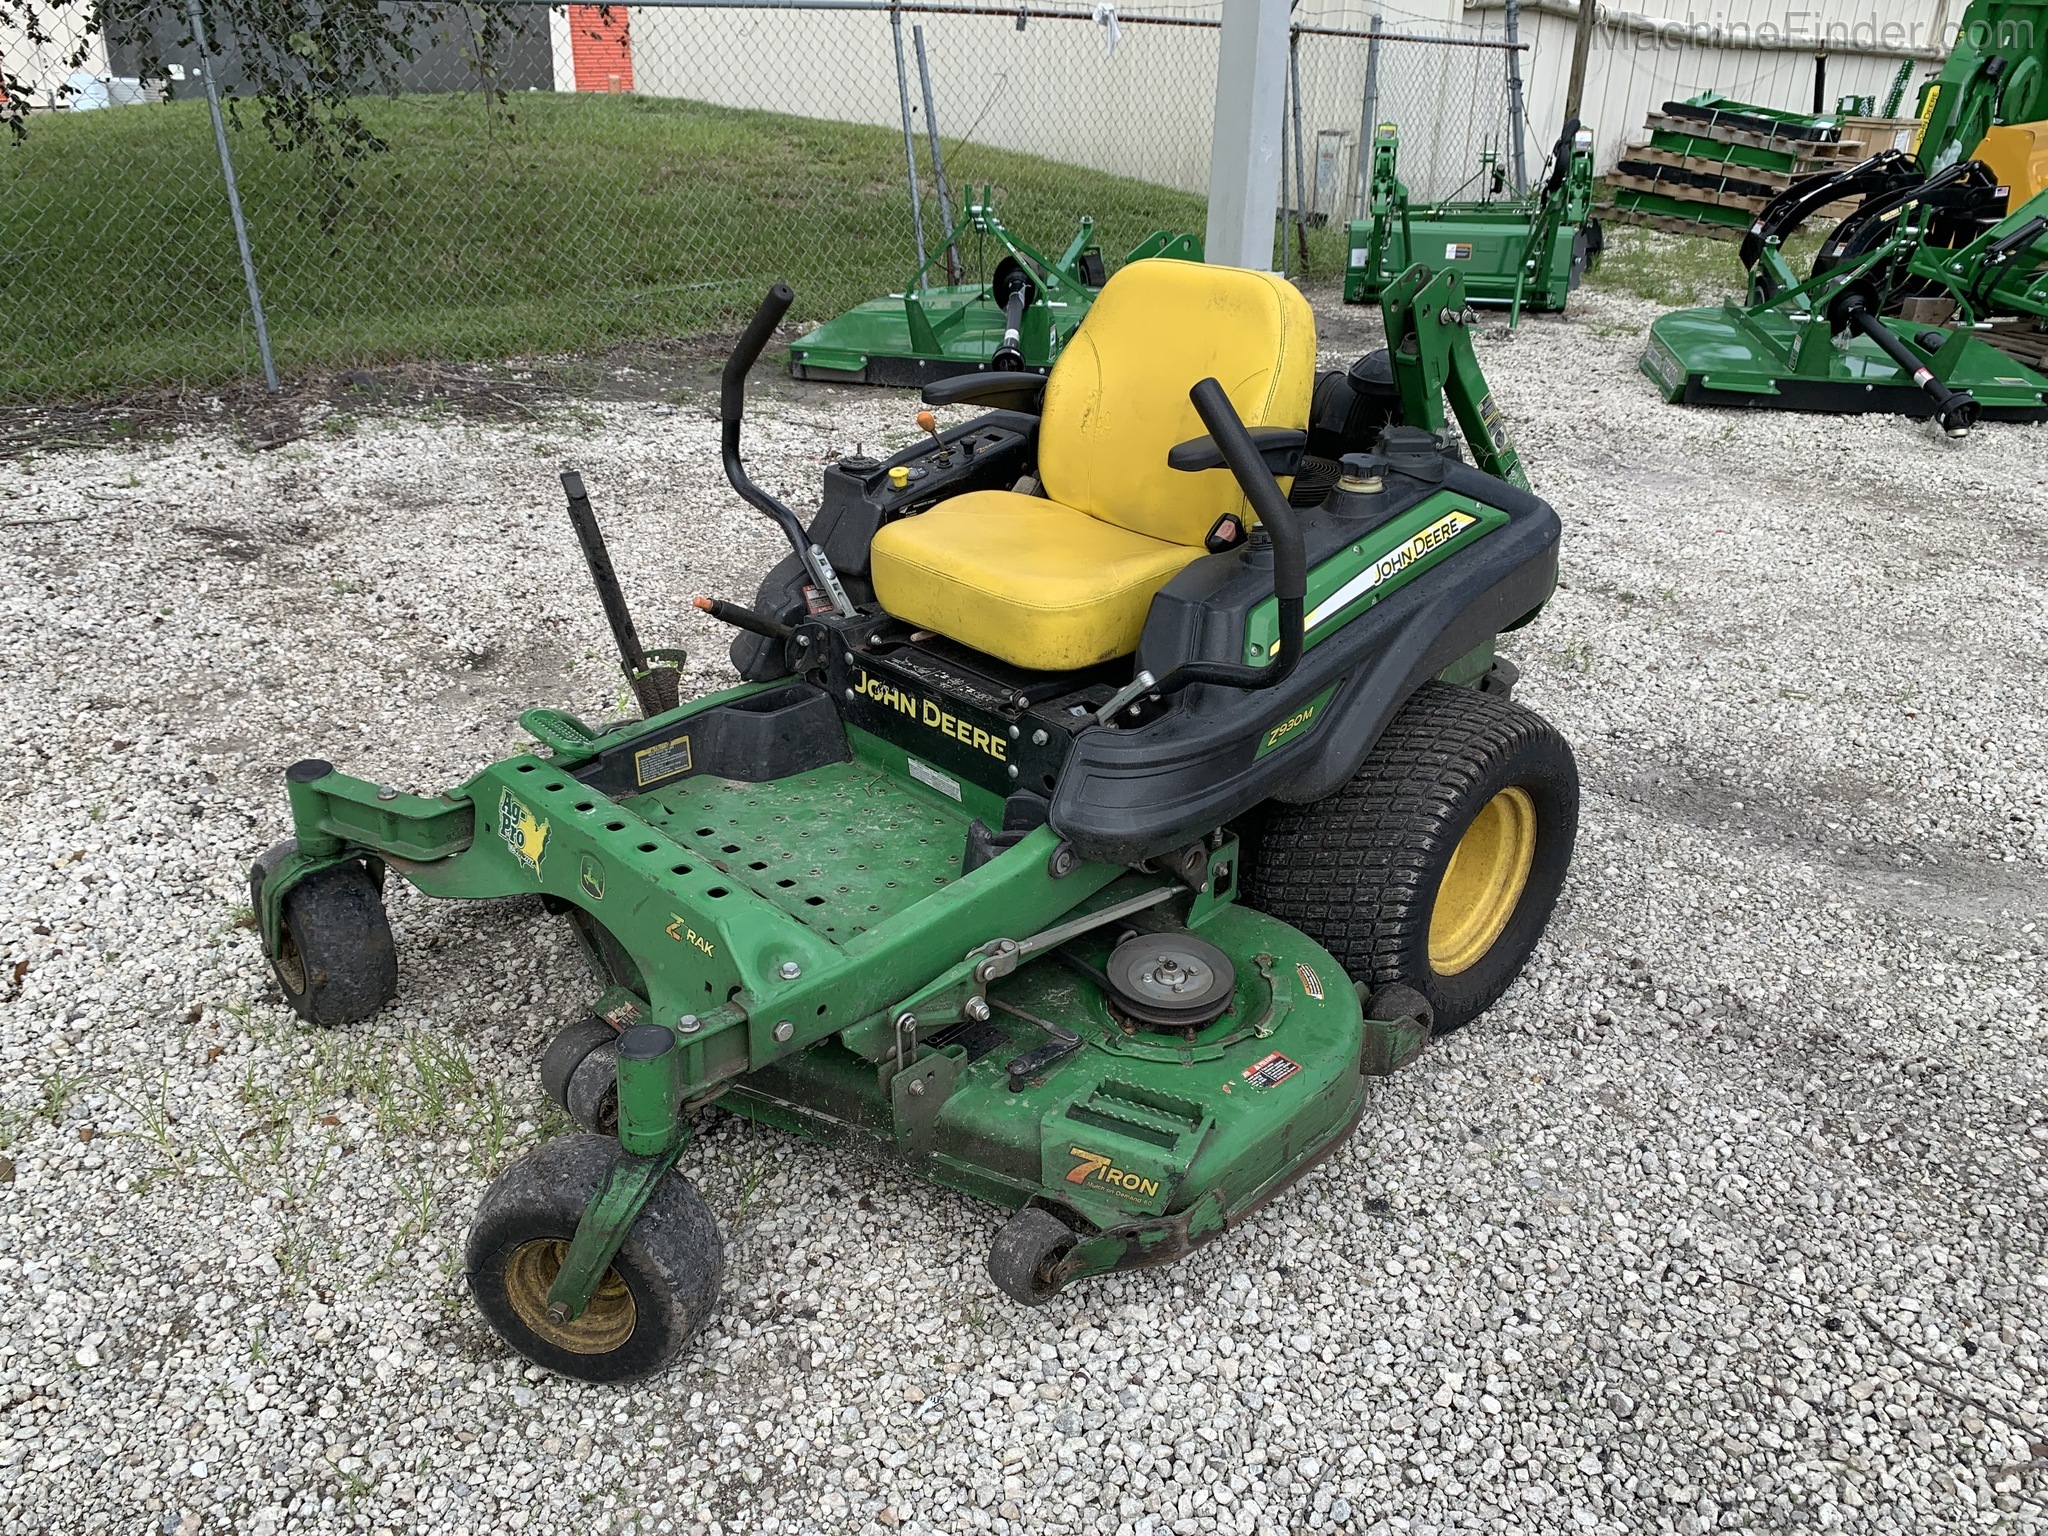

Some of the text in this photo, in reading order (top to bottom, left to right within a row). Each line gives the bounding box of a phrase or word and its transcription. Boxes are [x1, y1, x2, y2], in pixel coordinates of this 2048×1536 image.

[1916, 92, 1939, 143] JOHN DEERE
[1373, 518, 1460, 584] JOHN DEERE
[854, 670, 917, 719] JOHN
[922, 698, 1007, 762] DEERE
[1267, 706, 1315, 747] Z930M
[500, 813, 525, 847] Pro
[1086, 1181, 1105, 1191] Mulch
[1115, 1190, 1142, 1204] Demand
